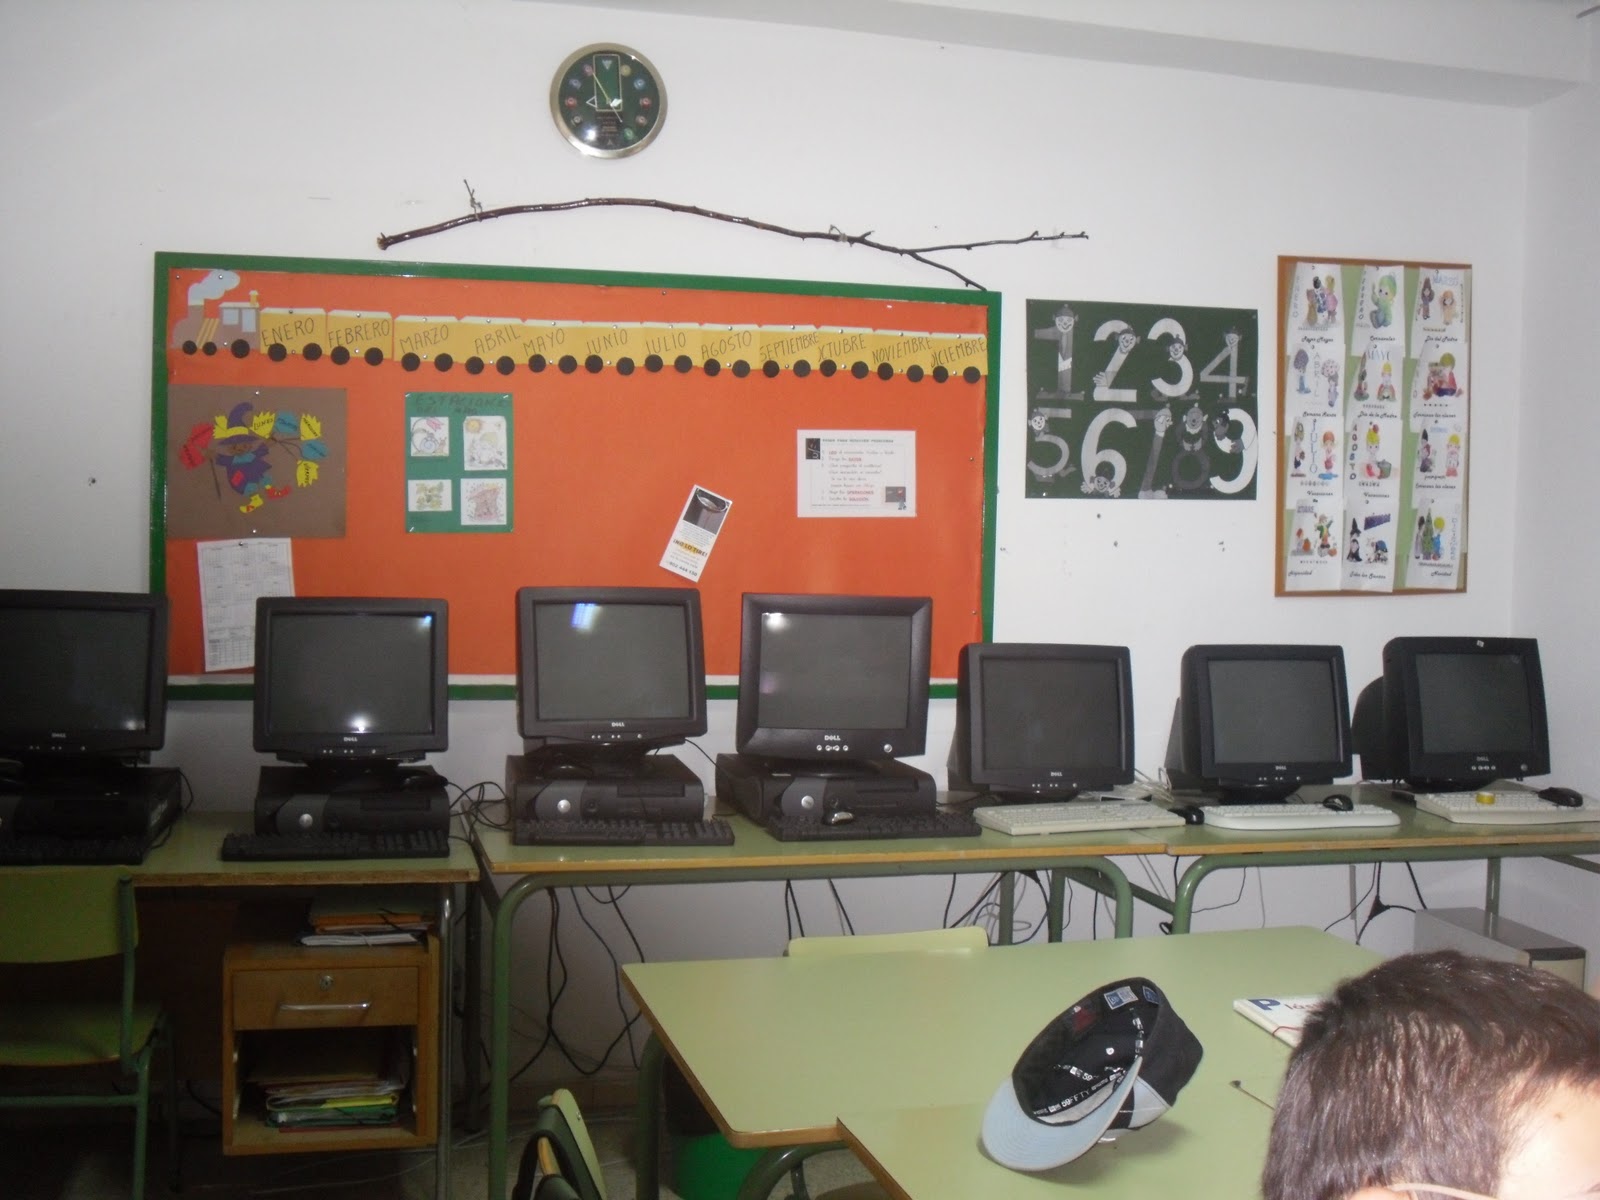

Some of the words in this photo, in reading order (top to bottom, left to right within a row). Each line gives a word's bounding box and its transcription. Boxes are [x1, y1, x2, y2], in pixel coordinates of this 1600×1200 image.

[261, 317, 315, 347] ENERO
[328, 319, 390, 348] FEBRERO
[399, 324, 449, 353] MARZO
[474, 325, 521, 354] ABRIL
[523, 328, 565, 356] MAYO
[583, 329, 628, 354] JUNIO
[645, 332, 687, 354] JULIO
[701, 330, 754, 359] AGOSTO
[760, 332, 820, 362] SEPTIEMBRE
[872, 337, 932, 364] NOVIEMBRE
[1093, 319, 1140, 403] 2
[1147, 317, 1194, 397] 3
[1199, 327, 1248, 400] 4
[1028, 406, 1072, 477] 5
[1080, 407, 1137, 498] 6
[1209, 407, 1259, 494] 9
